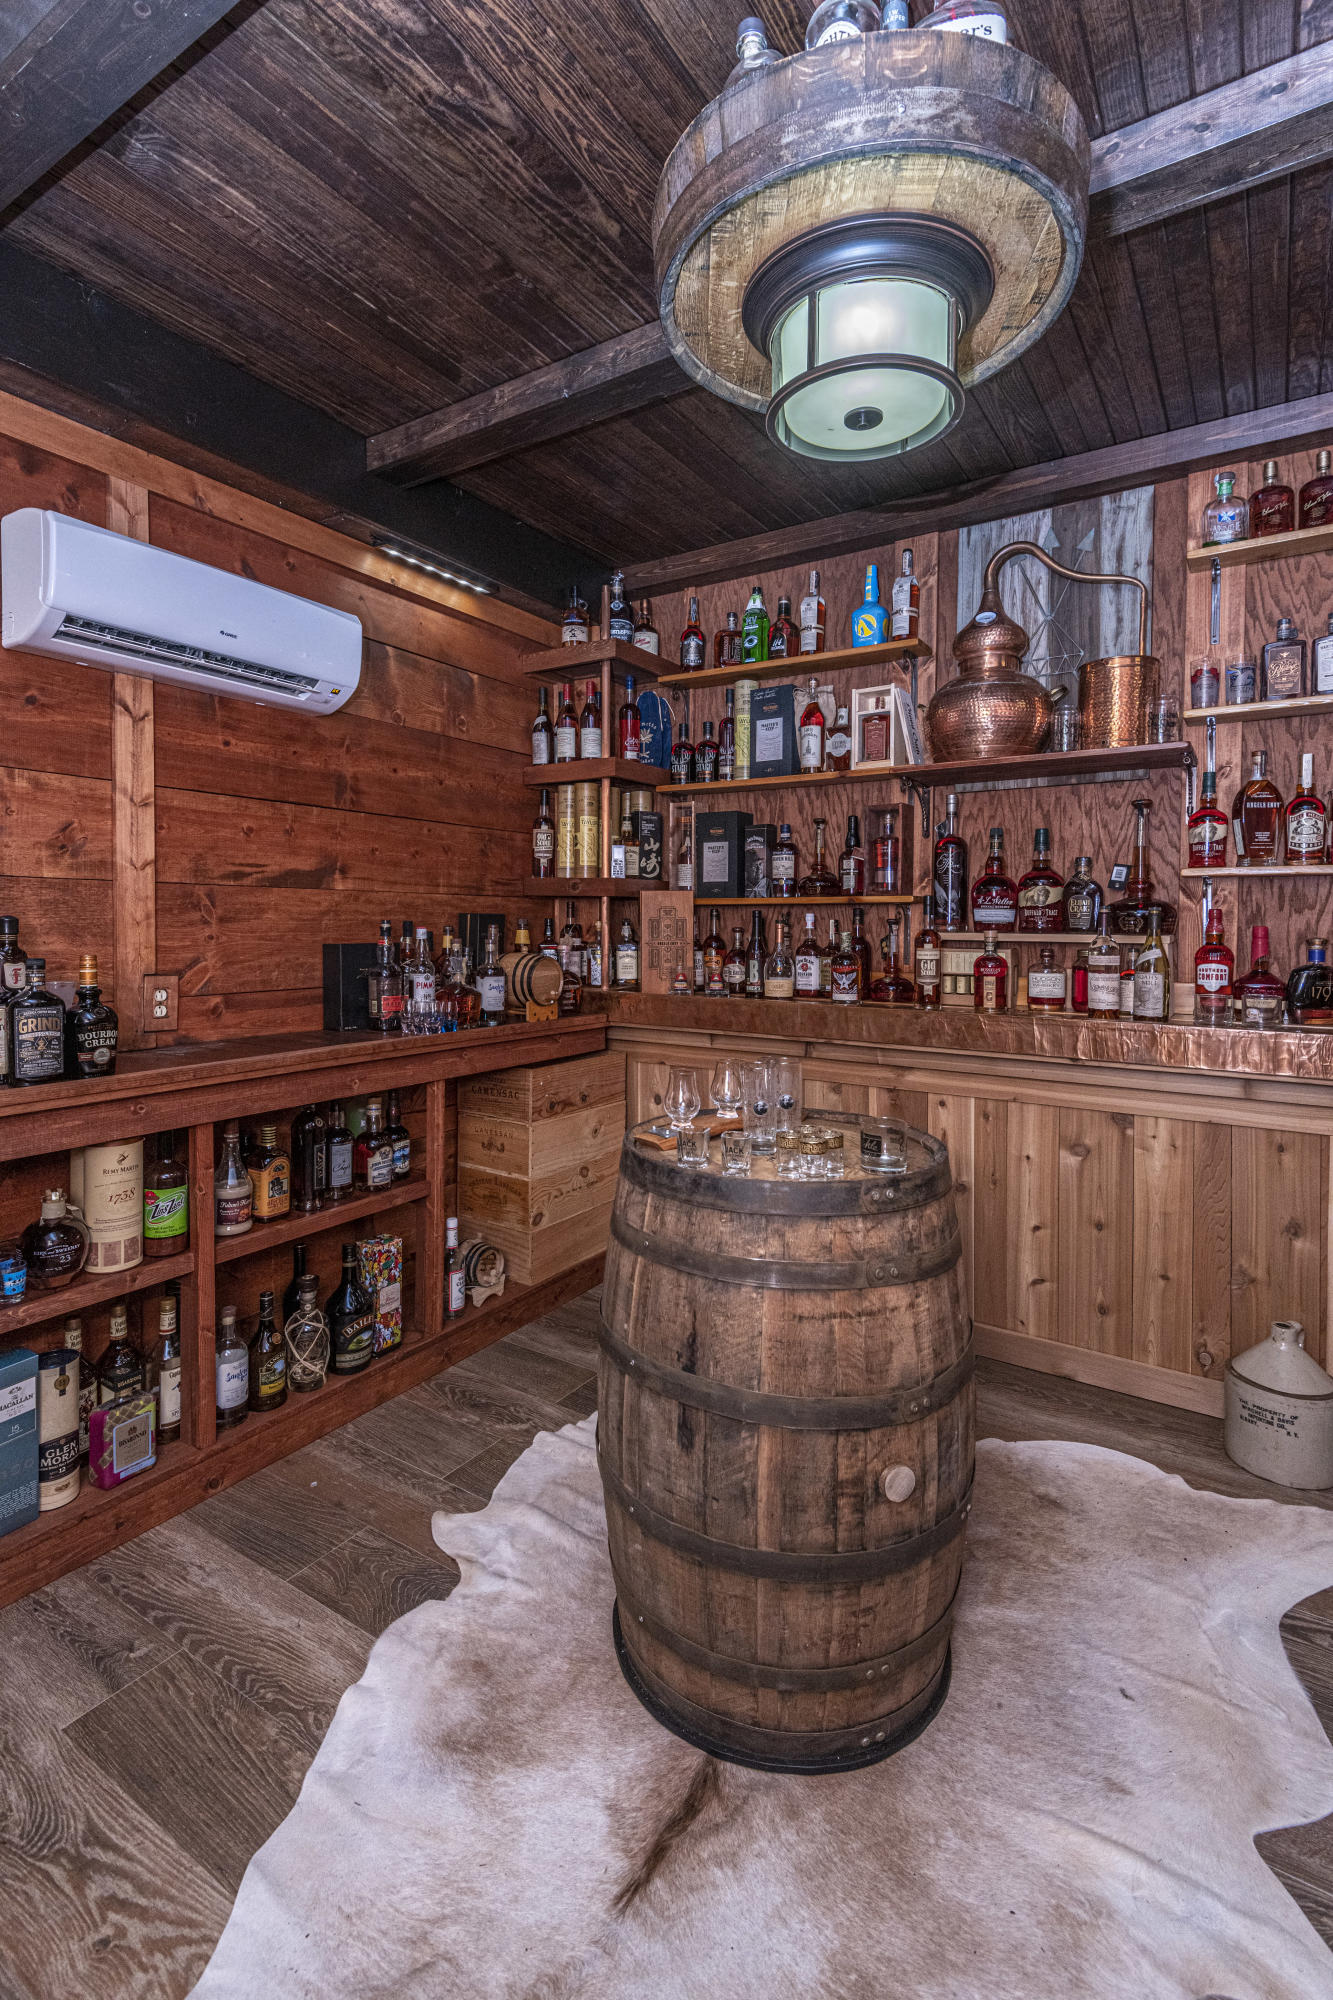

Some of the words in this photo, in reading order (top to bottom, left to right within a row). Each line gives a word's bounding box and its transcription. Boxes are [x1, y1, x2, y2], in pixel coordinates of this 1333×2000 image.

[1198, 973, 1227, 981] COMFORT
[18, 1017, 60, 1034] GRIND
[85, 1038, 116, 1048] CREAM
[108, 1187, 136, 1205] 1738
[40, 1446, 79, 1468] MORAY
[45, 1441, 77, 1459] GLEN
